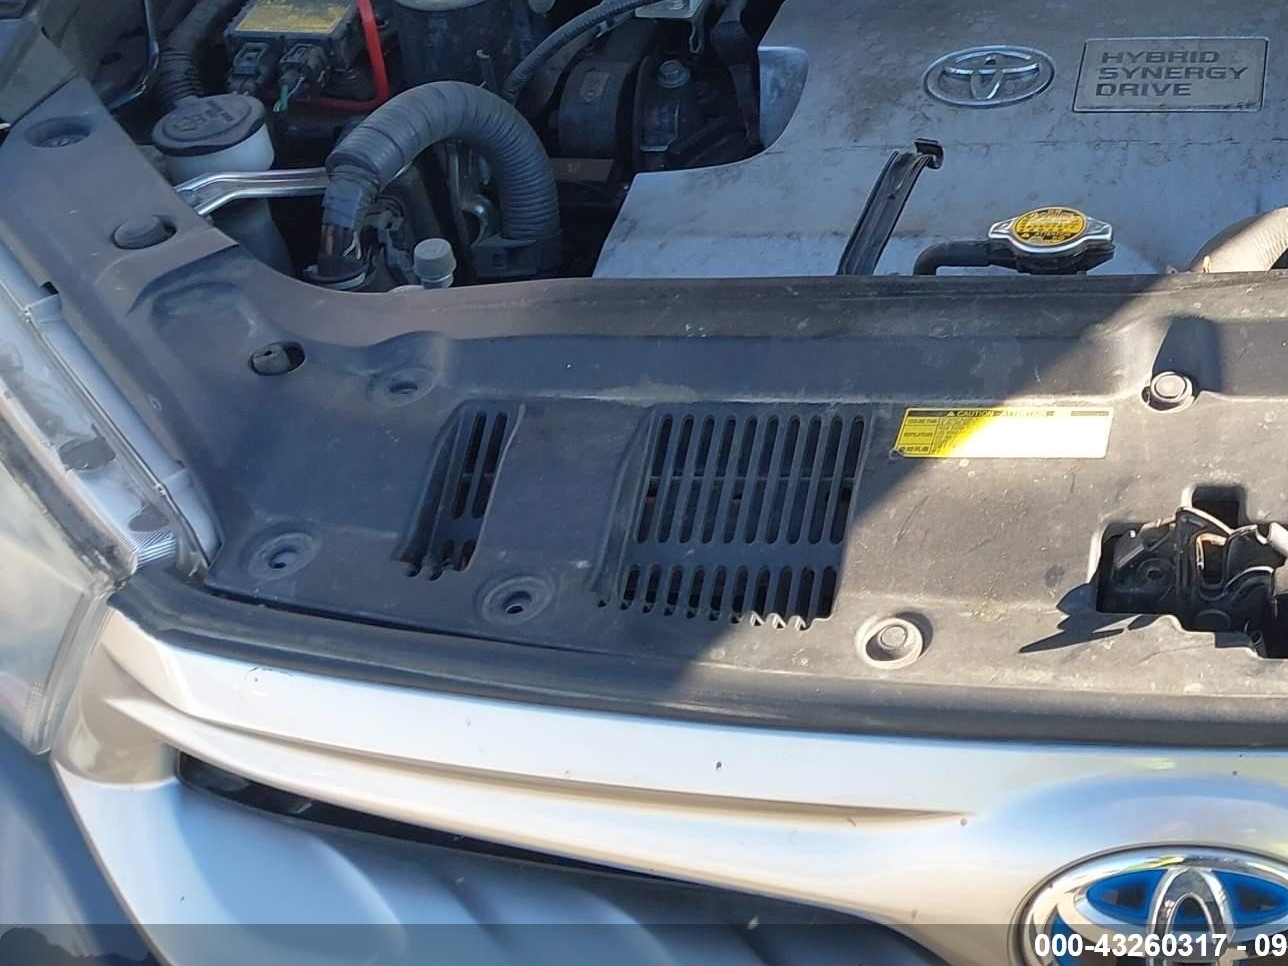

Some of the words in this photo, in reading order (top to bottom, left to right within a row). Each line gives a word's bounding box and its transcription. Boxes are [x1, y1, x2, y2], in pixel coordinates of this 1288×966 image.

[1102, 51, 1220, 63] HYBRID
[1098, 67, 1249, 80] SYNERGY
[1095, 83, 1193, 97] DRIVE
[957, 410, 994, 418] CAUTION
